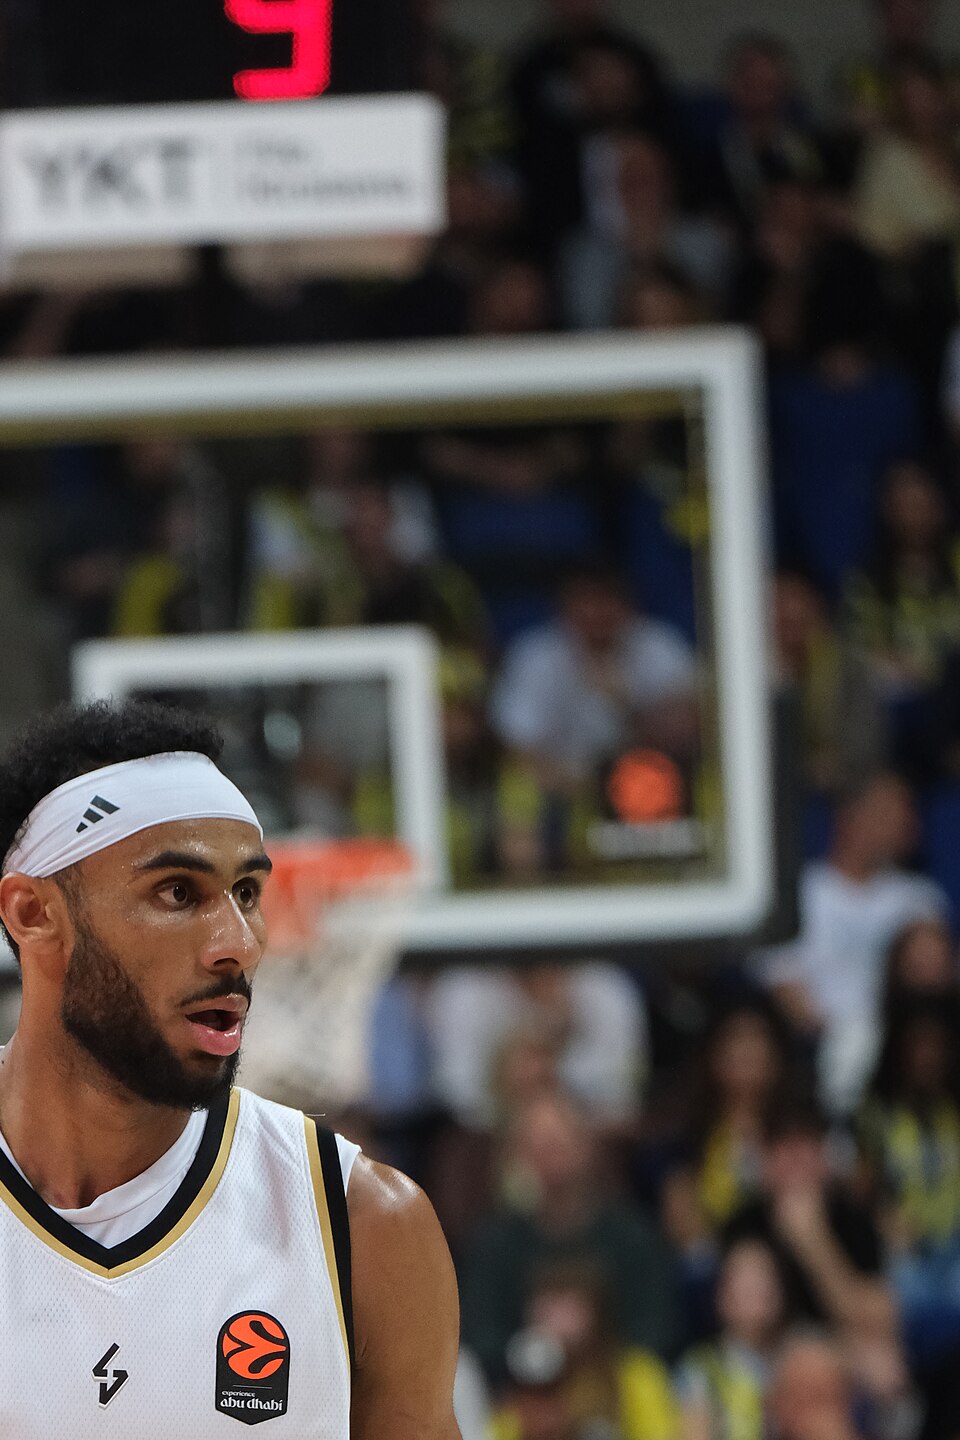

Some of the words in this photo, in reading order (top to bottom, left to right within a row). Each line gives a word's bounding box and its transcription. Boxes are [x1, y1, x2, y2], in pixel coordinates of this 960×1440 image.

[221, 1390, 256, 1398] experience
[220, 1397, 245, 1408] abu
[246, 1398, 283, 1411] dhabi
